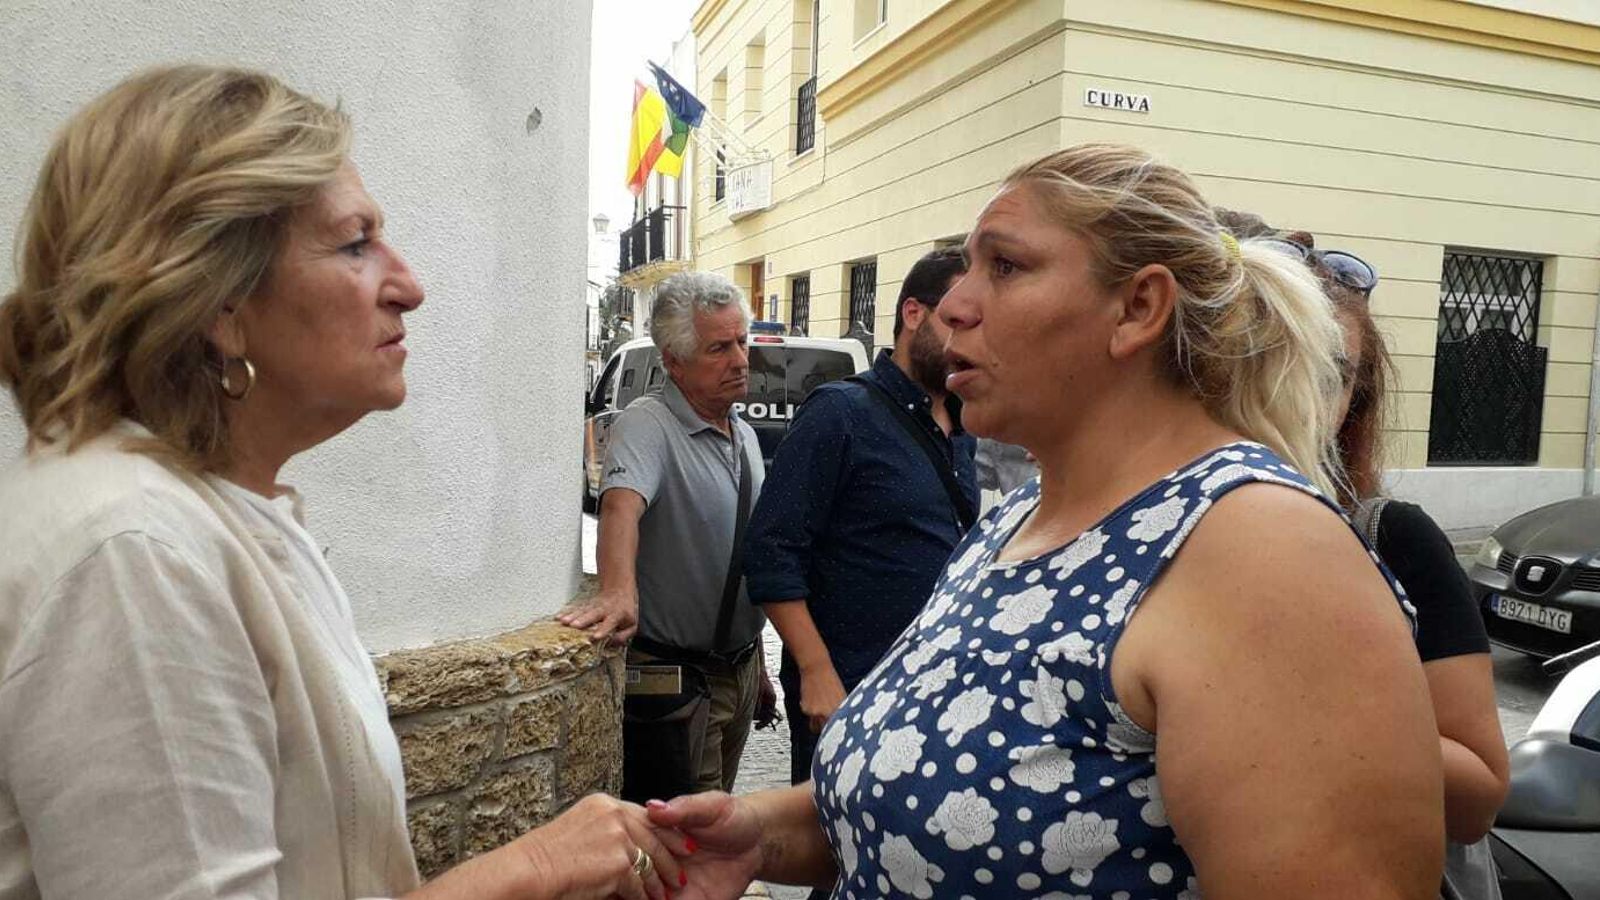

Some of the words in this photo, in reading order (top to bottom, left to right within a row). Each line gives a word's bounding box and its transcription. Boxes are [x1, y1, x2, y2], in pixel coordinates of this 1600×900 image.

[1088, 90, 1149, 111] CURVA
[731, 402, 800, 419] POLI
[1500, 599, 1532, 620] 8971
[1538, 608, 1567, 630] DYG
